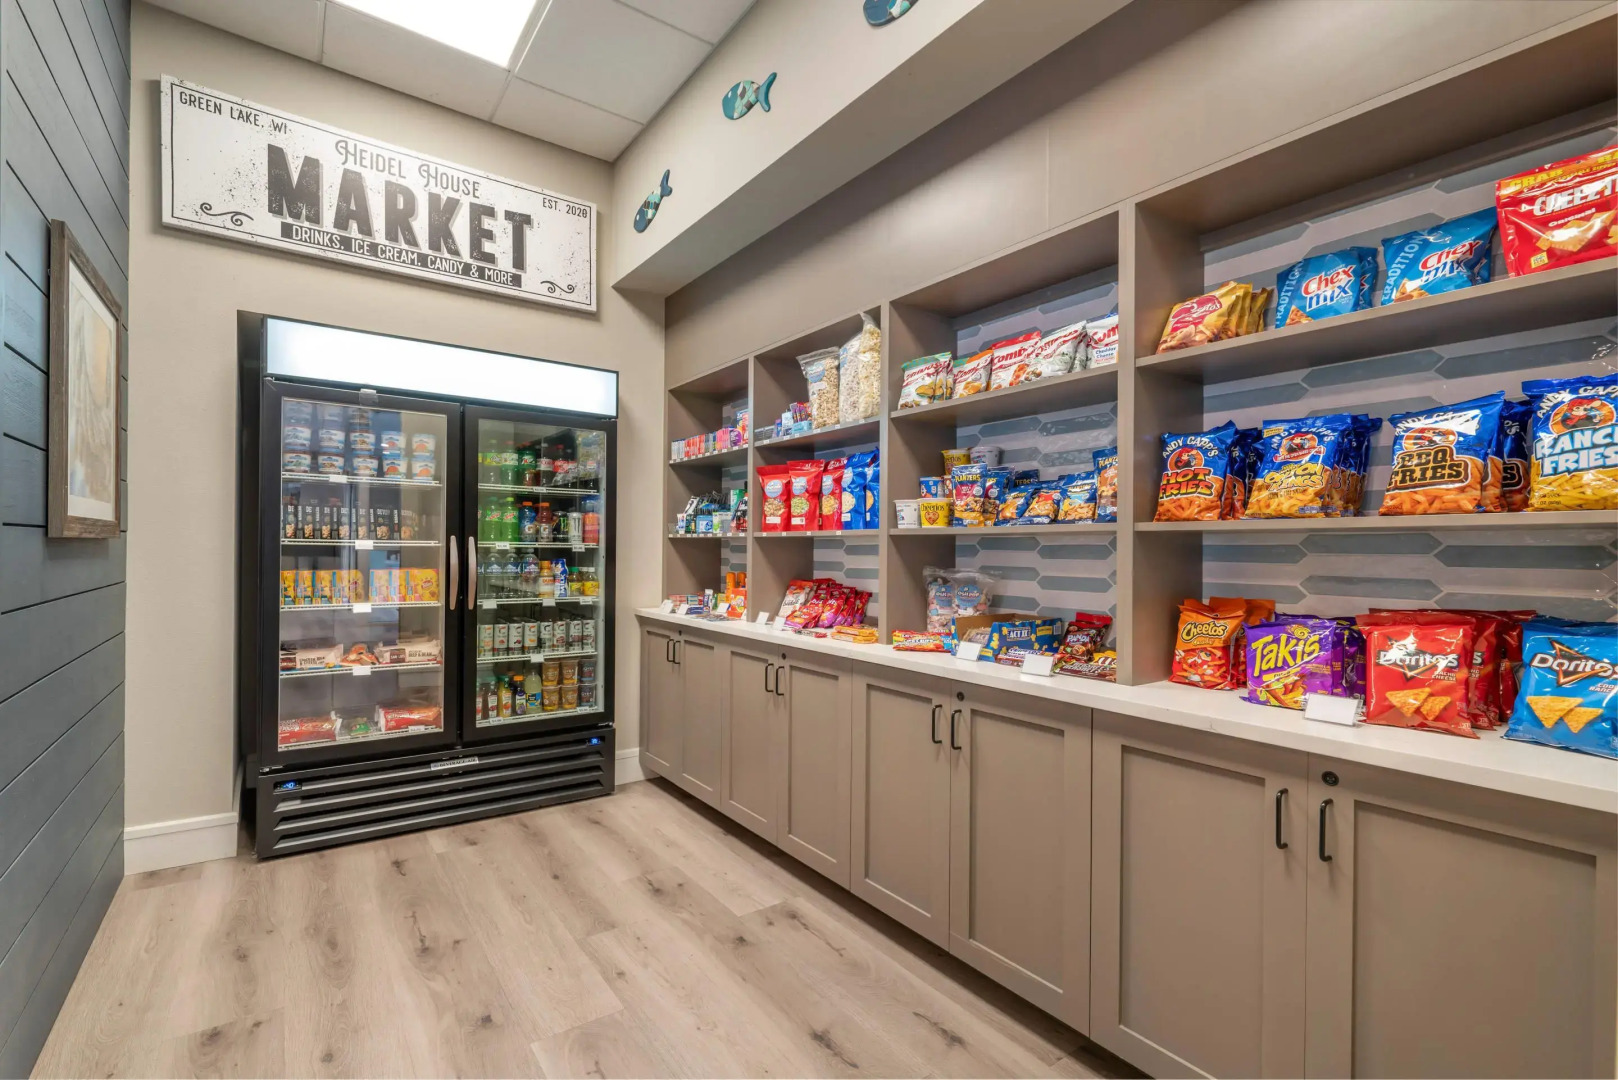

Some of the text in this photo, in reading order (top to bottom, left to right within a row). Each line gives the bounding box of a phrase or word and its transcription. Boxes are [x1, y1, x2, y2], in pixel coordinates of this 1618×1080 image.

[179, 91, 289, 136] GREEN LAKE, WI
[334, 139, 481, 199] HEIDEL HOUSE
[267, 143, 533, 273] MARKET
[542, 197, 563, 212] EST.
[291, 225, 515, 286] DRINKS, ICE CREAM, CANDY & MORE
[1418, 239, 1483, 272] Chex
[1302, 264, 1357, 297] Chex
[1537, 388, 1571, 418] ANDY
[1162, 436, 1219, 459] ANDY CAPP'S
[1271, 428, 1296, 450] ANDY
[1542, 445, 1618, 476] FRIES
[1162, 468, 1210, 485] HOT
[1388, 462, 1463, 487] FRIES
[1159, 480, 1214, 498] FRIES
[1009, 630, 1021, 638] ACT
[1181, 621, 1228, 641] Cheetos
[1380, 650, 1459, 668] Doritos
